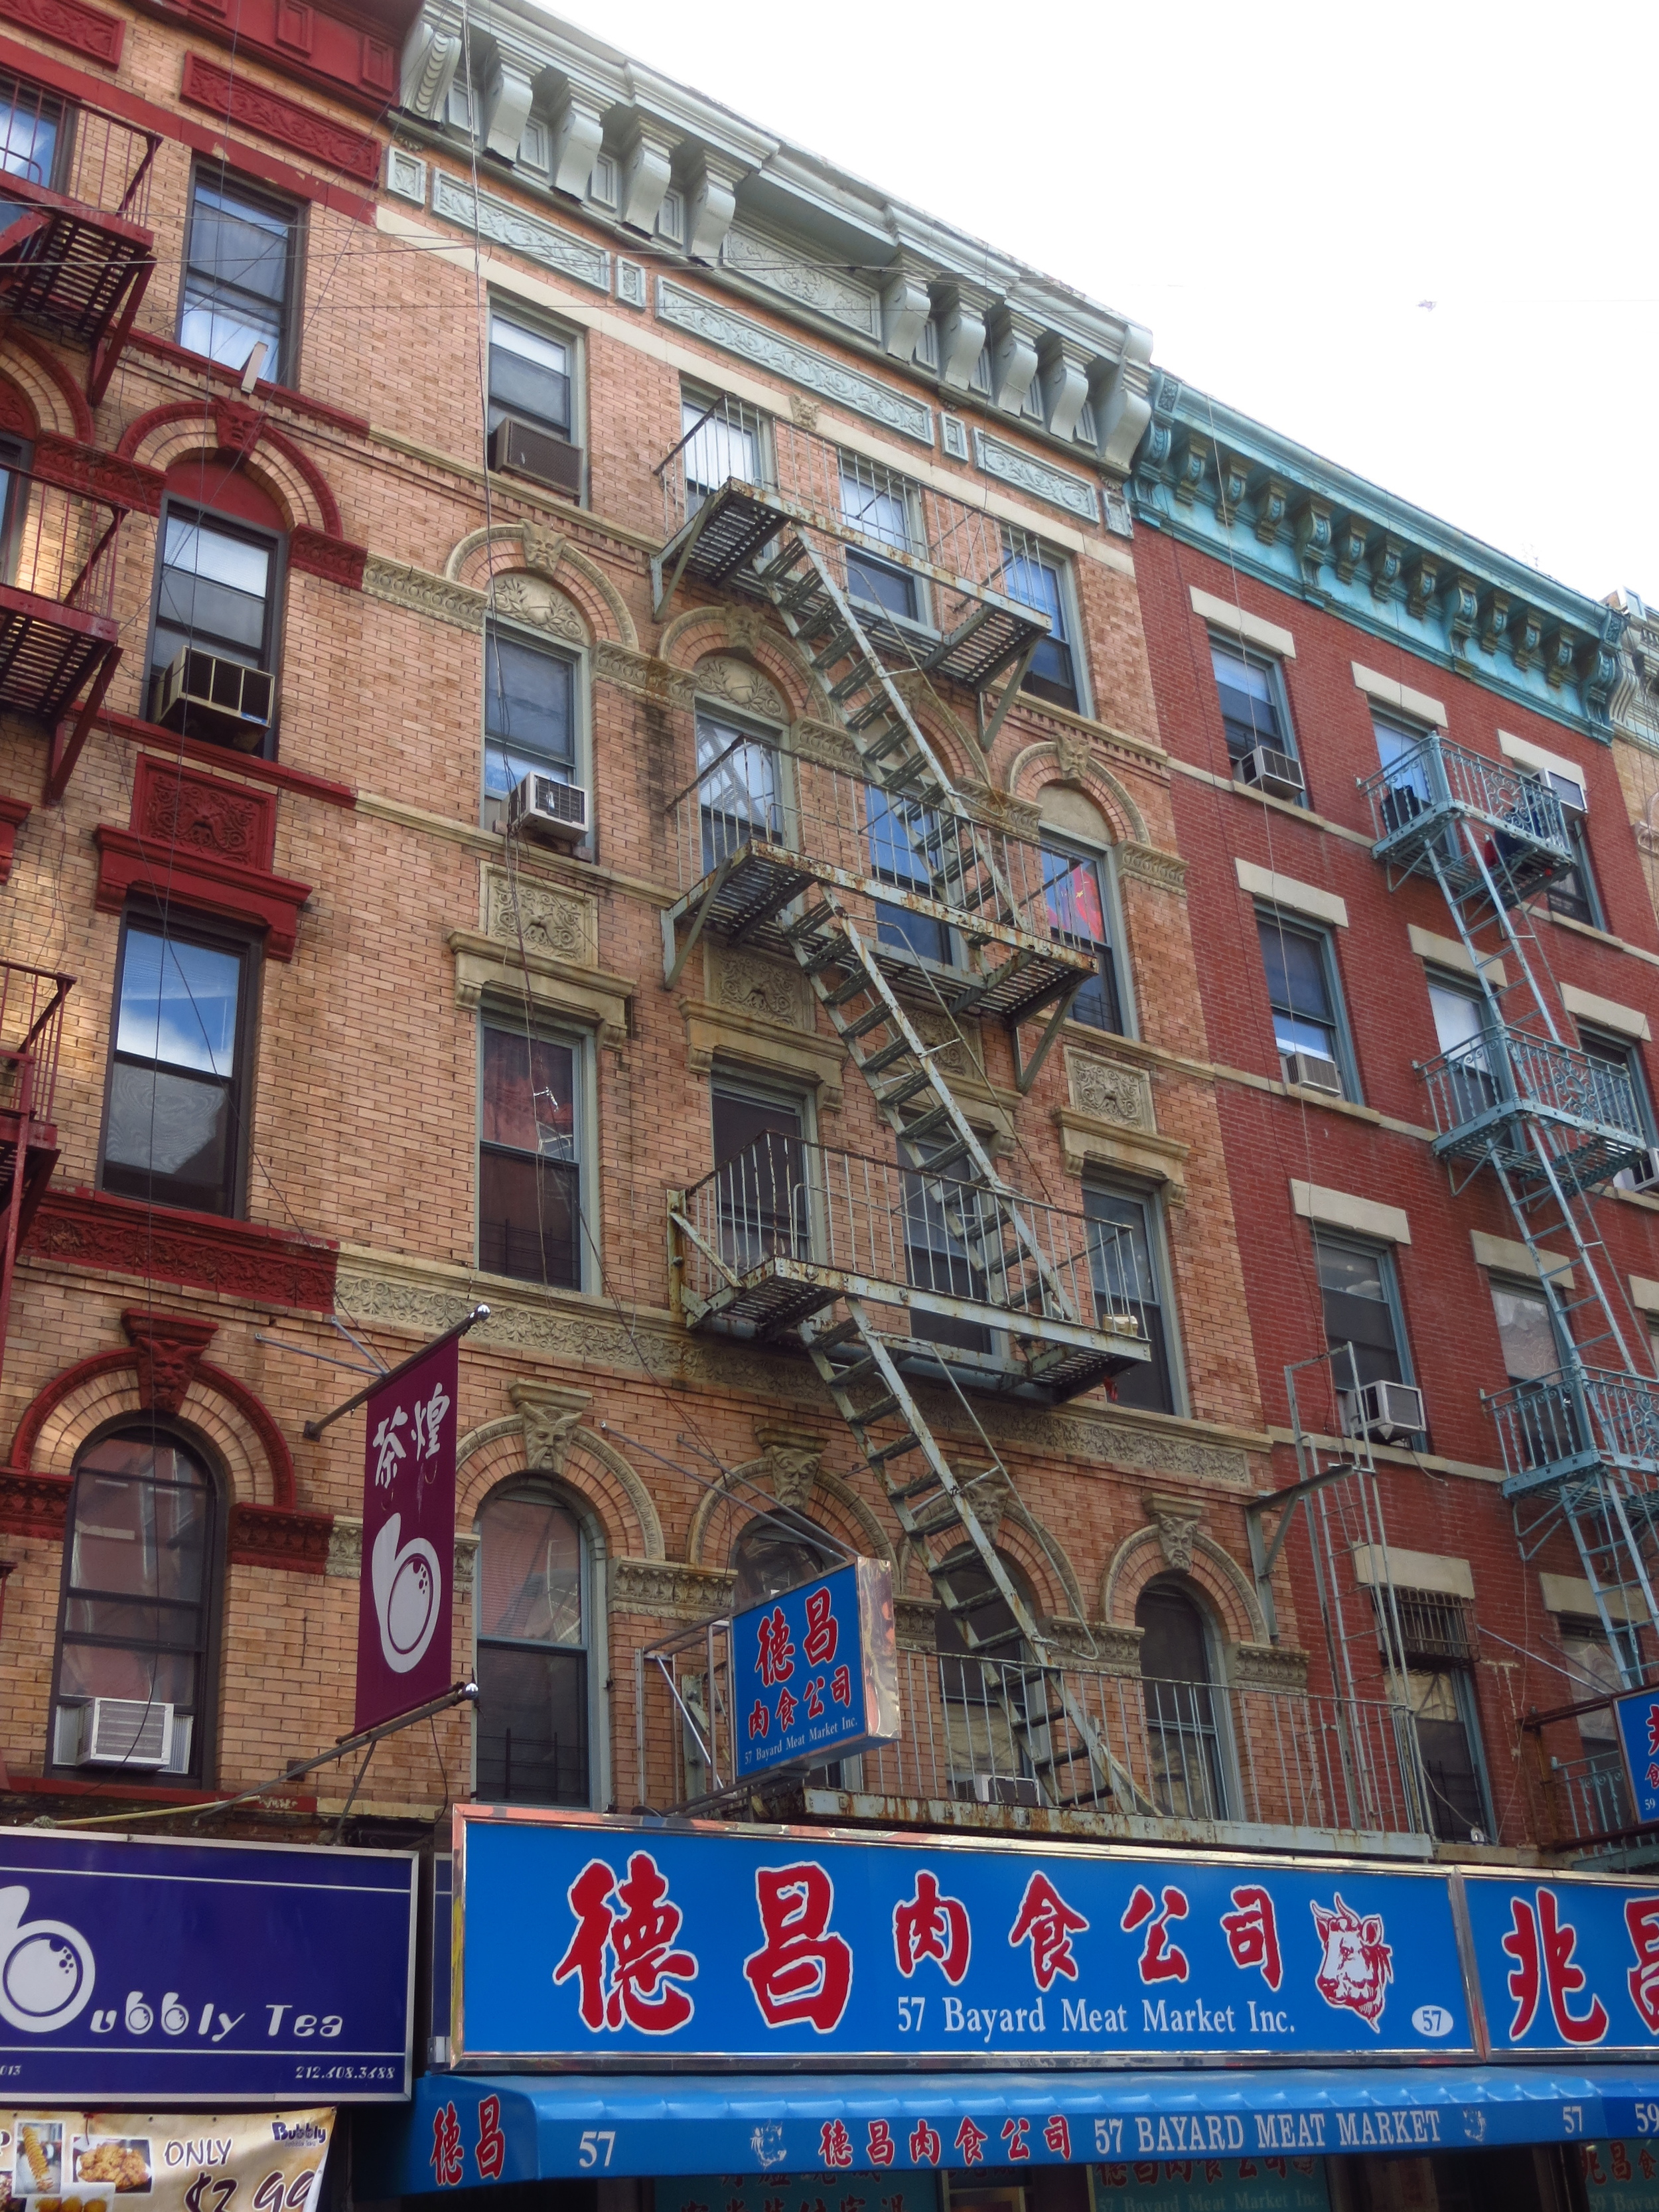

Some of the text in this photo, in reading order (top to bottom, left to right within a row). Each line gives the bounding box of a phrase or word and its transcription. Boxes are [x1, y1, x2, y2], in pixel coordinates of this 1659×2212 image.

[755, 1586, 838, 1688] 德昌
[749, 1664, 851, 1740] 肉食公司
[745, 1716, 857, 1765] 57 Bayard Meat Market Inc.
[553, 1850, 1283, 2033] 德昌肉食公司
[266, 2004, 343, 2037] Tea
[898, 1996, 1295, 2043] 57 Bayard Meat Market Inc.
[1421, 2010, 1442, 2032] 57
[271, 2121, 326, 2144] Bubbly
[430, 2093, 505, 2185] 德昌
[1094, 2110, 1441, 2154] 57 BAYARD MEAT MARKET
[1563, 2106, 1583, 2134] 57
[1635, 2103, 1659, 2132] 59
[165, 2138, 232, 2167] ONLY
[579, 2131, 616, 2168] 57
[818, 2114, 1072, 2168] 德昌肉食公司
